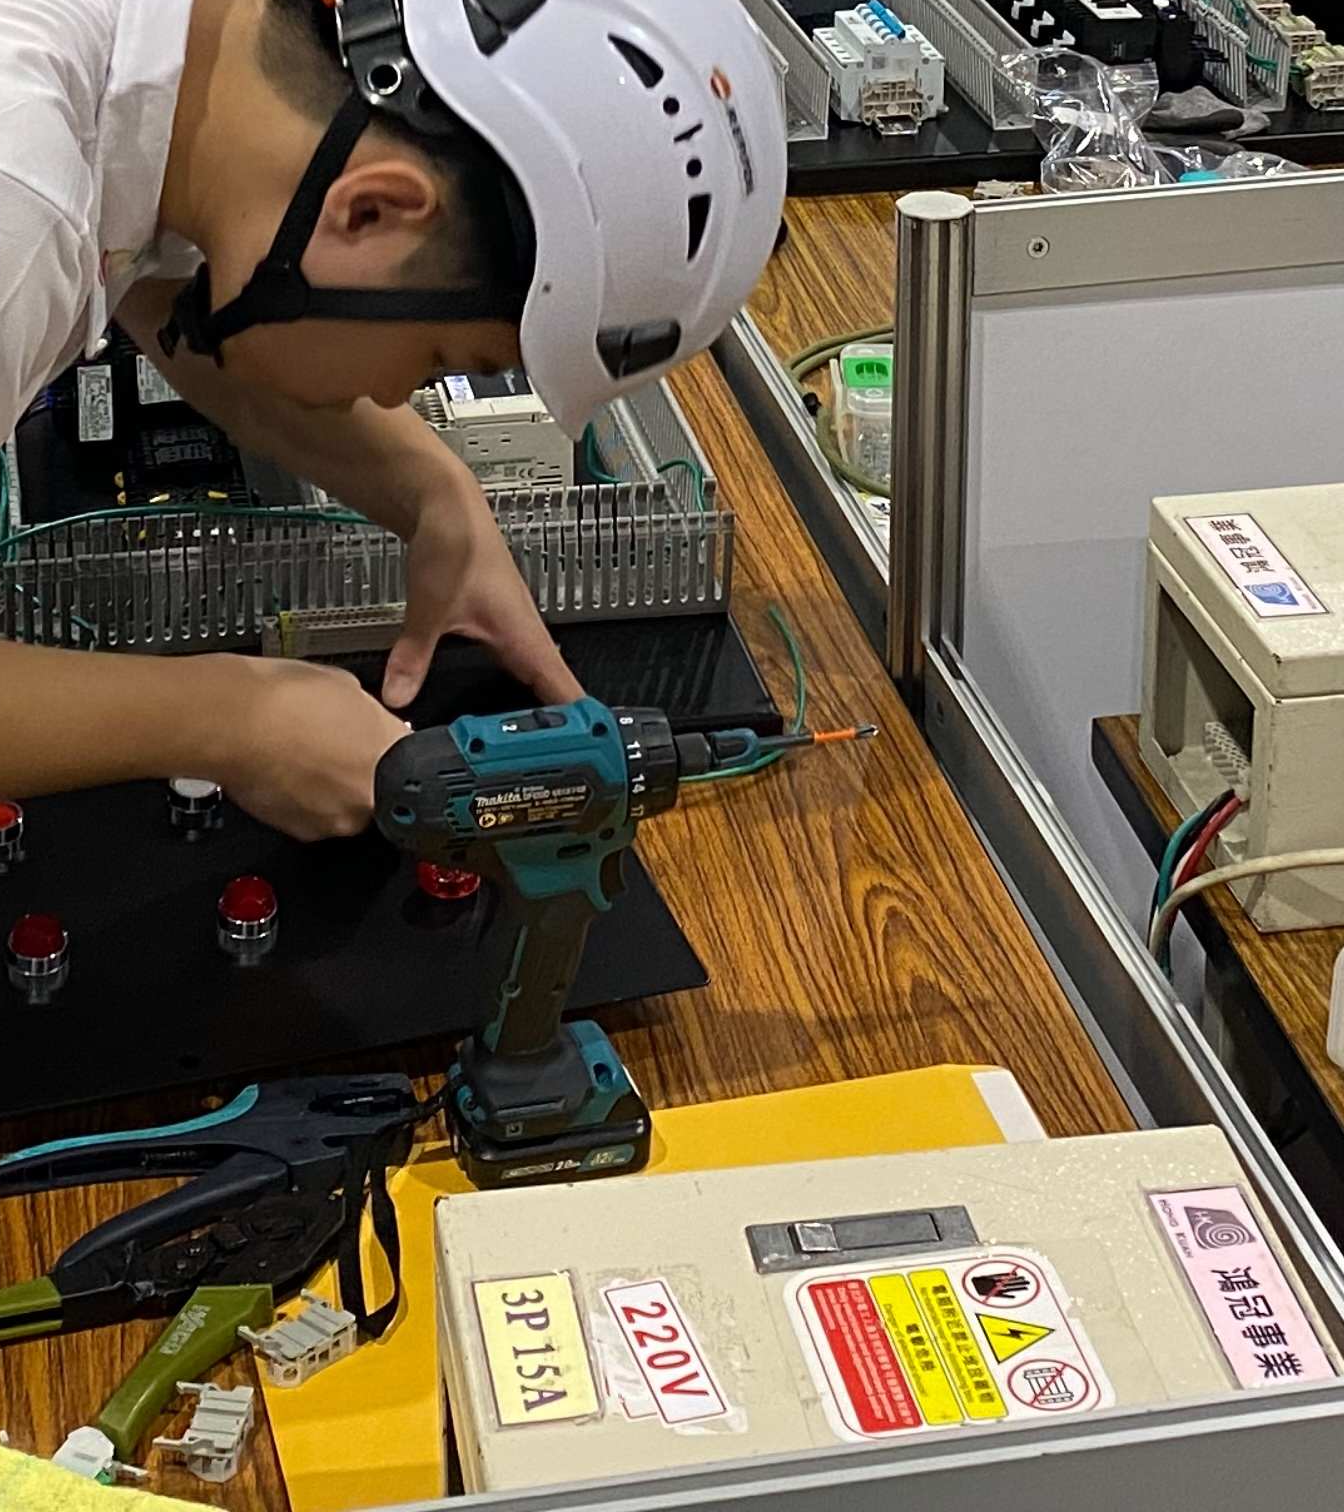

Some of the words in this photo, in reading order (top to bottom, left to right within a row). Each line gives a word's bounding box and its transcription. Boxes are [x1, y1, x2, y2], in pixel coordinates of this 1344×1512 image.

[626, 740, 642, 761] 11
[631, 774, 646, 794] 14
[501, 1289, 550, 1332] 3P
[1211, 1266, 1304, 1379] 鴻冠事業
[512, 1342, 568, 1412] 15A
[621, 1301, 709, 1398] 220V
